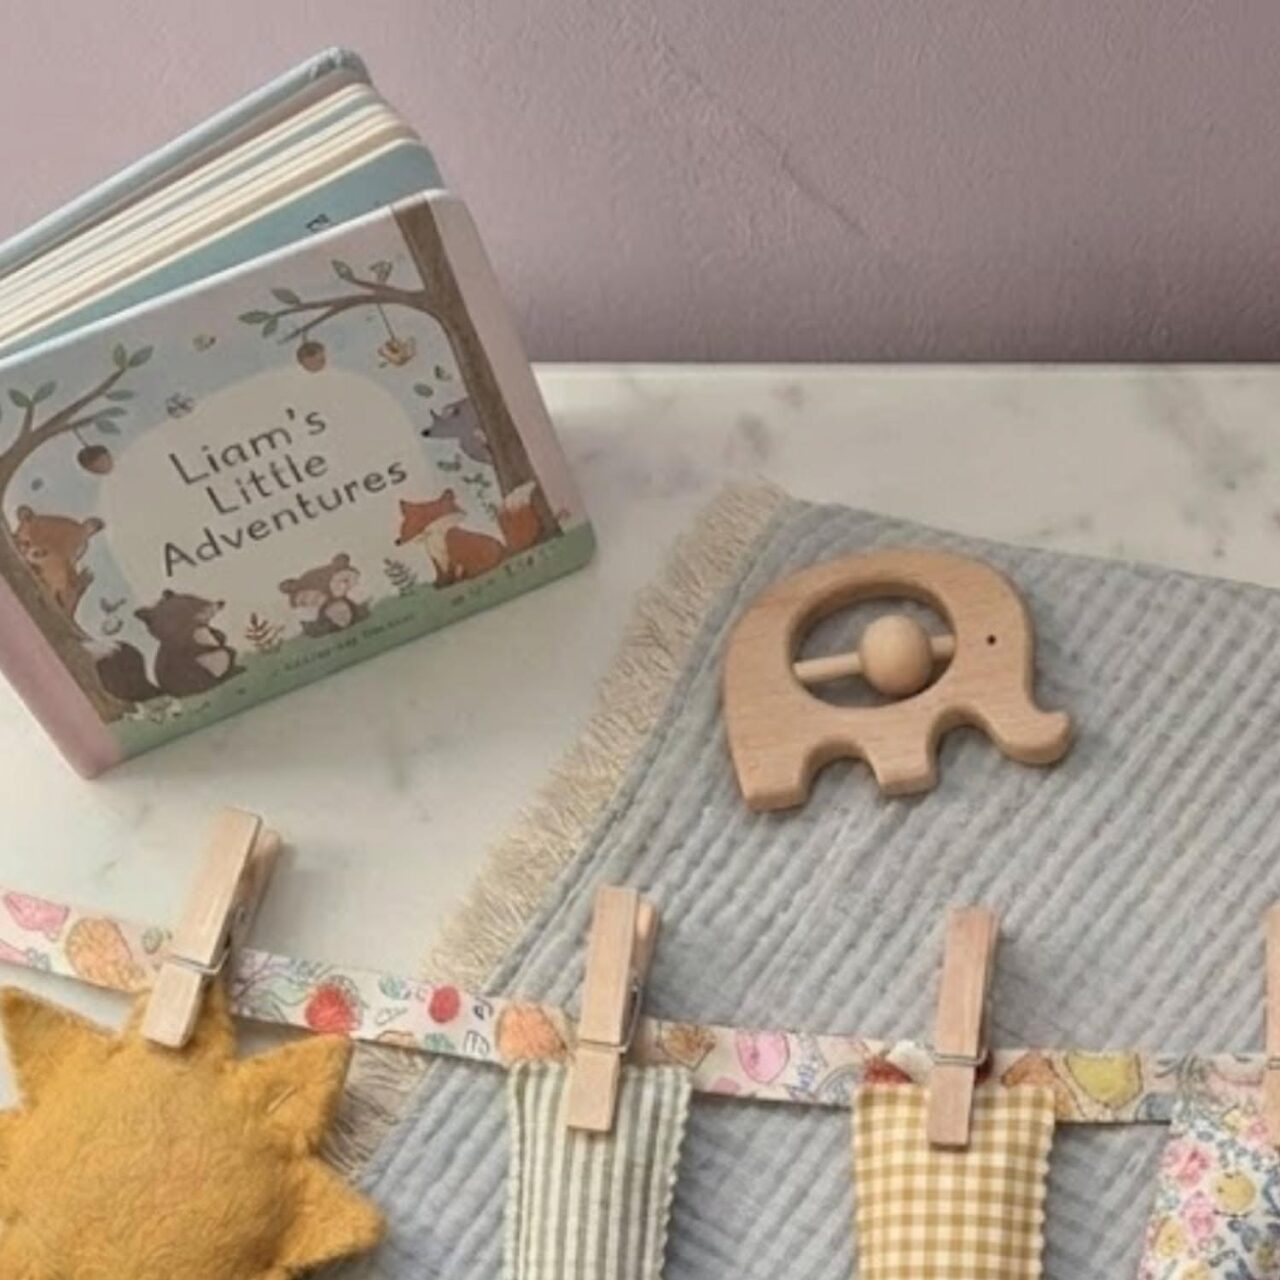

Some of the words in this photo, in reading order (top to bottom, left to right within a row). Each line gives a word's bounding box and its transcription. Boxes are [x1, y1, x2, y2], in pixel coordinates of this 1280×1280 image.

[168, 407, 327, 486] Liam's
[205, 453, 329, 515] Little
[163, 461, 408, 578] Adventures
